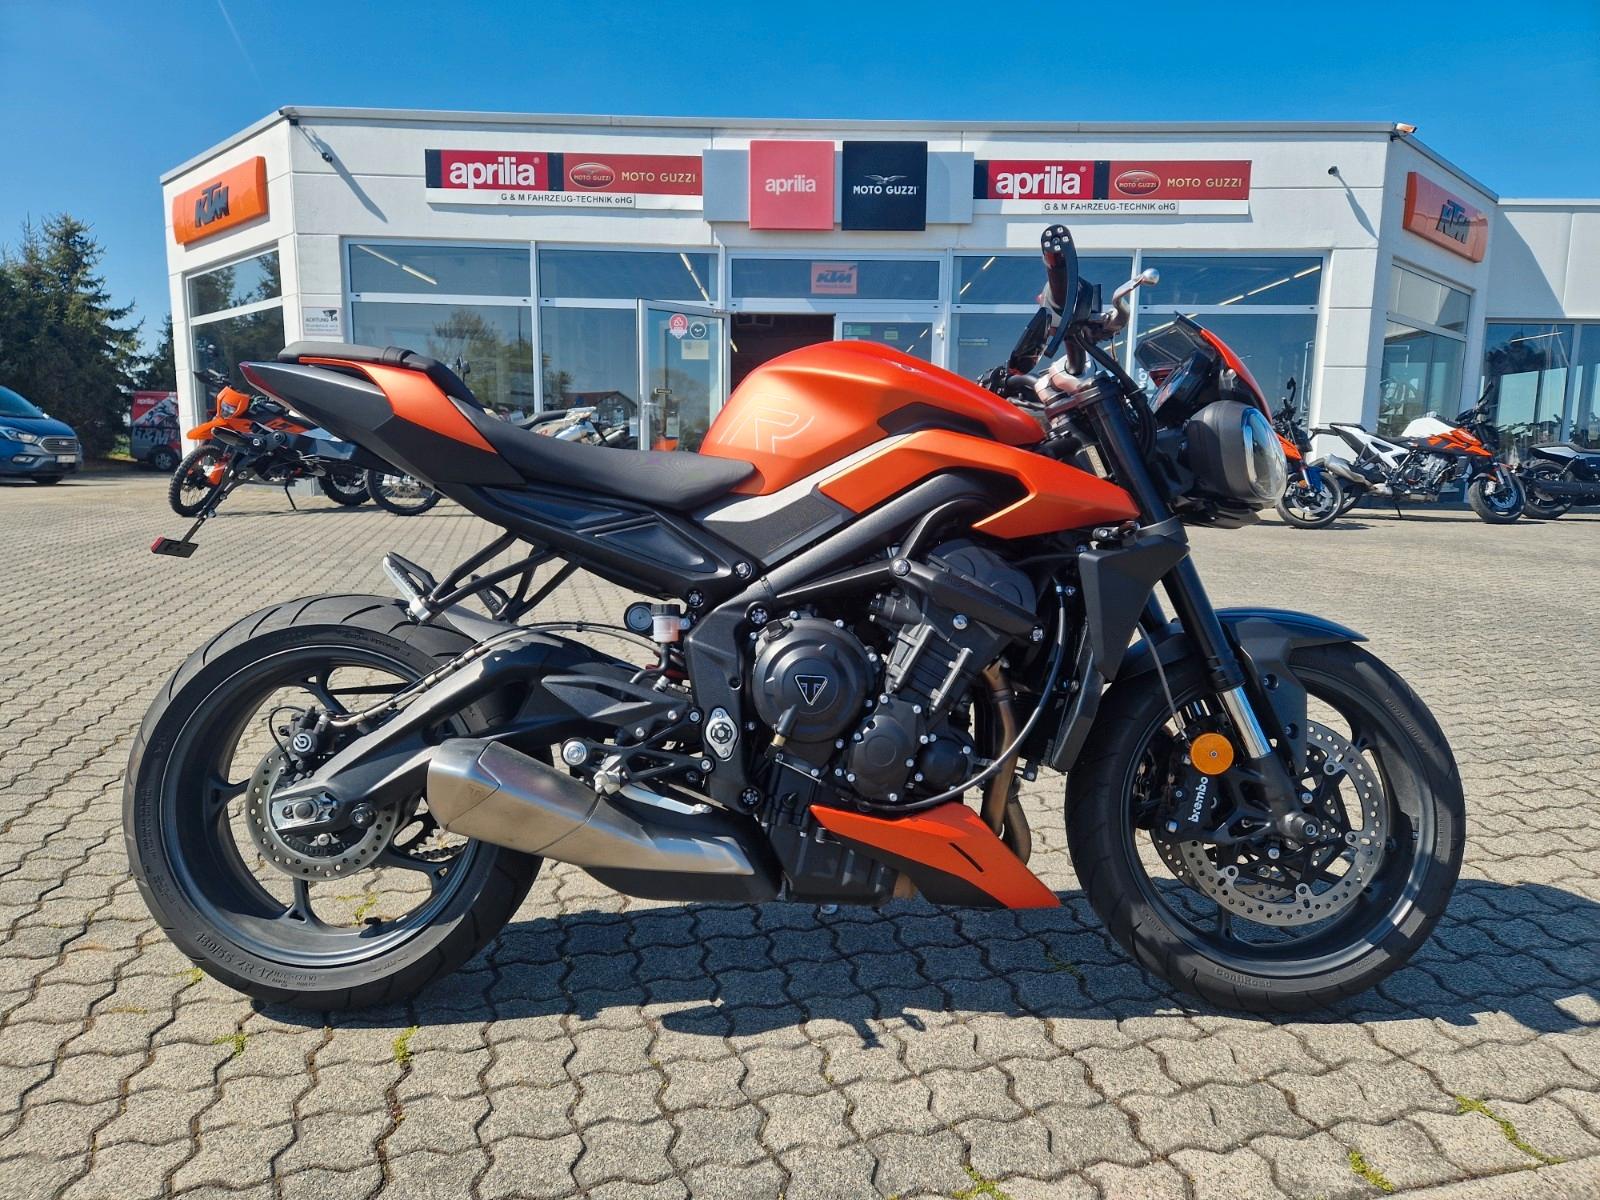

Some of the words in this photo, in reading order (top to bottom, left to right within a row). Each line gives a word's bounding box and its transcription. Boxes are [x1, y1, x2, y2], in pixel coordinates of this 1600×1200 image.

[449, 156, 536, 189] aprilia
[621, 171, 658, 182] MOTO
[660, 172, 696, 183] GUZZI
[764, 174, 817, 195] aprilia
[853, 185, 882, 195] MOTO
[886, 186, 917, 195] GUZZI
[996, 166, 1081, 200] aprilia
[1167, 177, 1201, 188] MOTO
[1205, 177, 1243, 188] GUZZI
[195, 182, 230, 229] KTM
[501, 192, 507, 201] G
[509, 193, 516, 201] &
[527, 194, 613, 204] FAHRZEUG-TECHNIK
[615, 196, 633, 204] oHG
[1044, 203, 1050, 211] G
[1052, 203, 1059, 211] &
[1060, 203, 1068, 211] M
[1070, 202, 1156, 211] FAHRZEUG-TECHNIK
[1158, 203, 1176, 211] oHG
[1435, 199, 1470, 244] KTM
[816, 269, 852, 283] KTM
[1187, 776, 1209, 823] brembo
